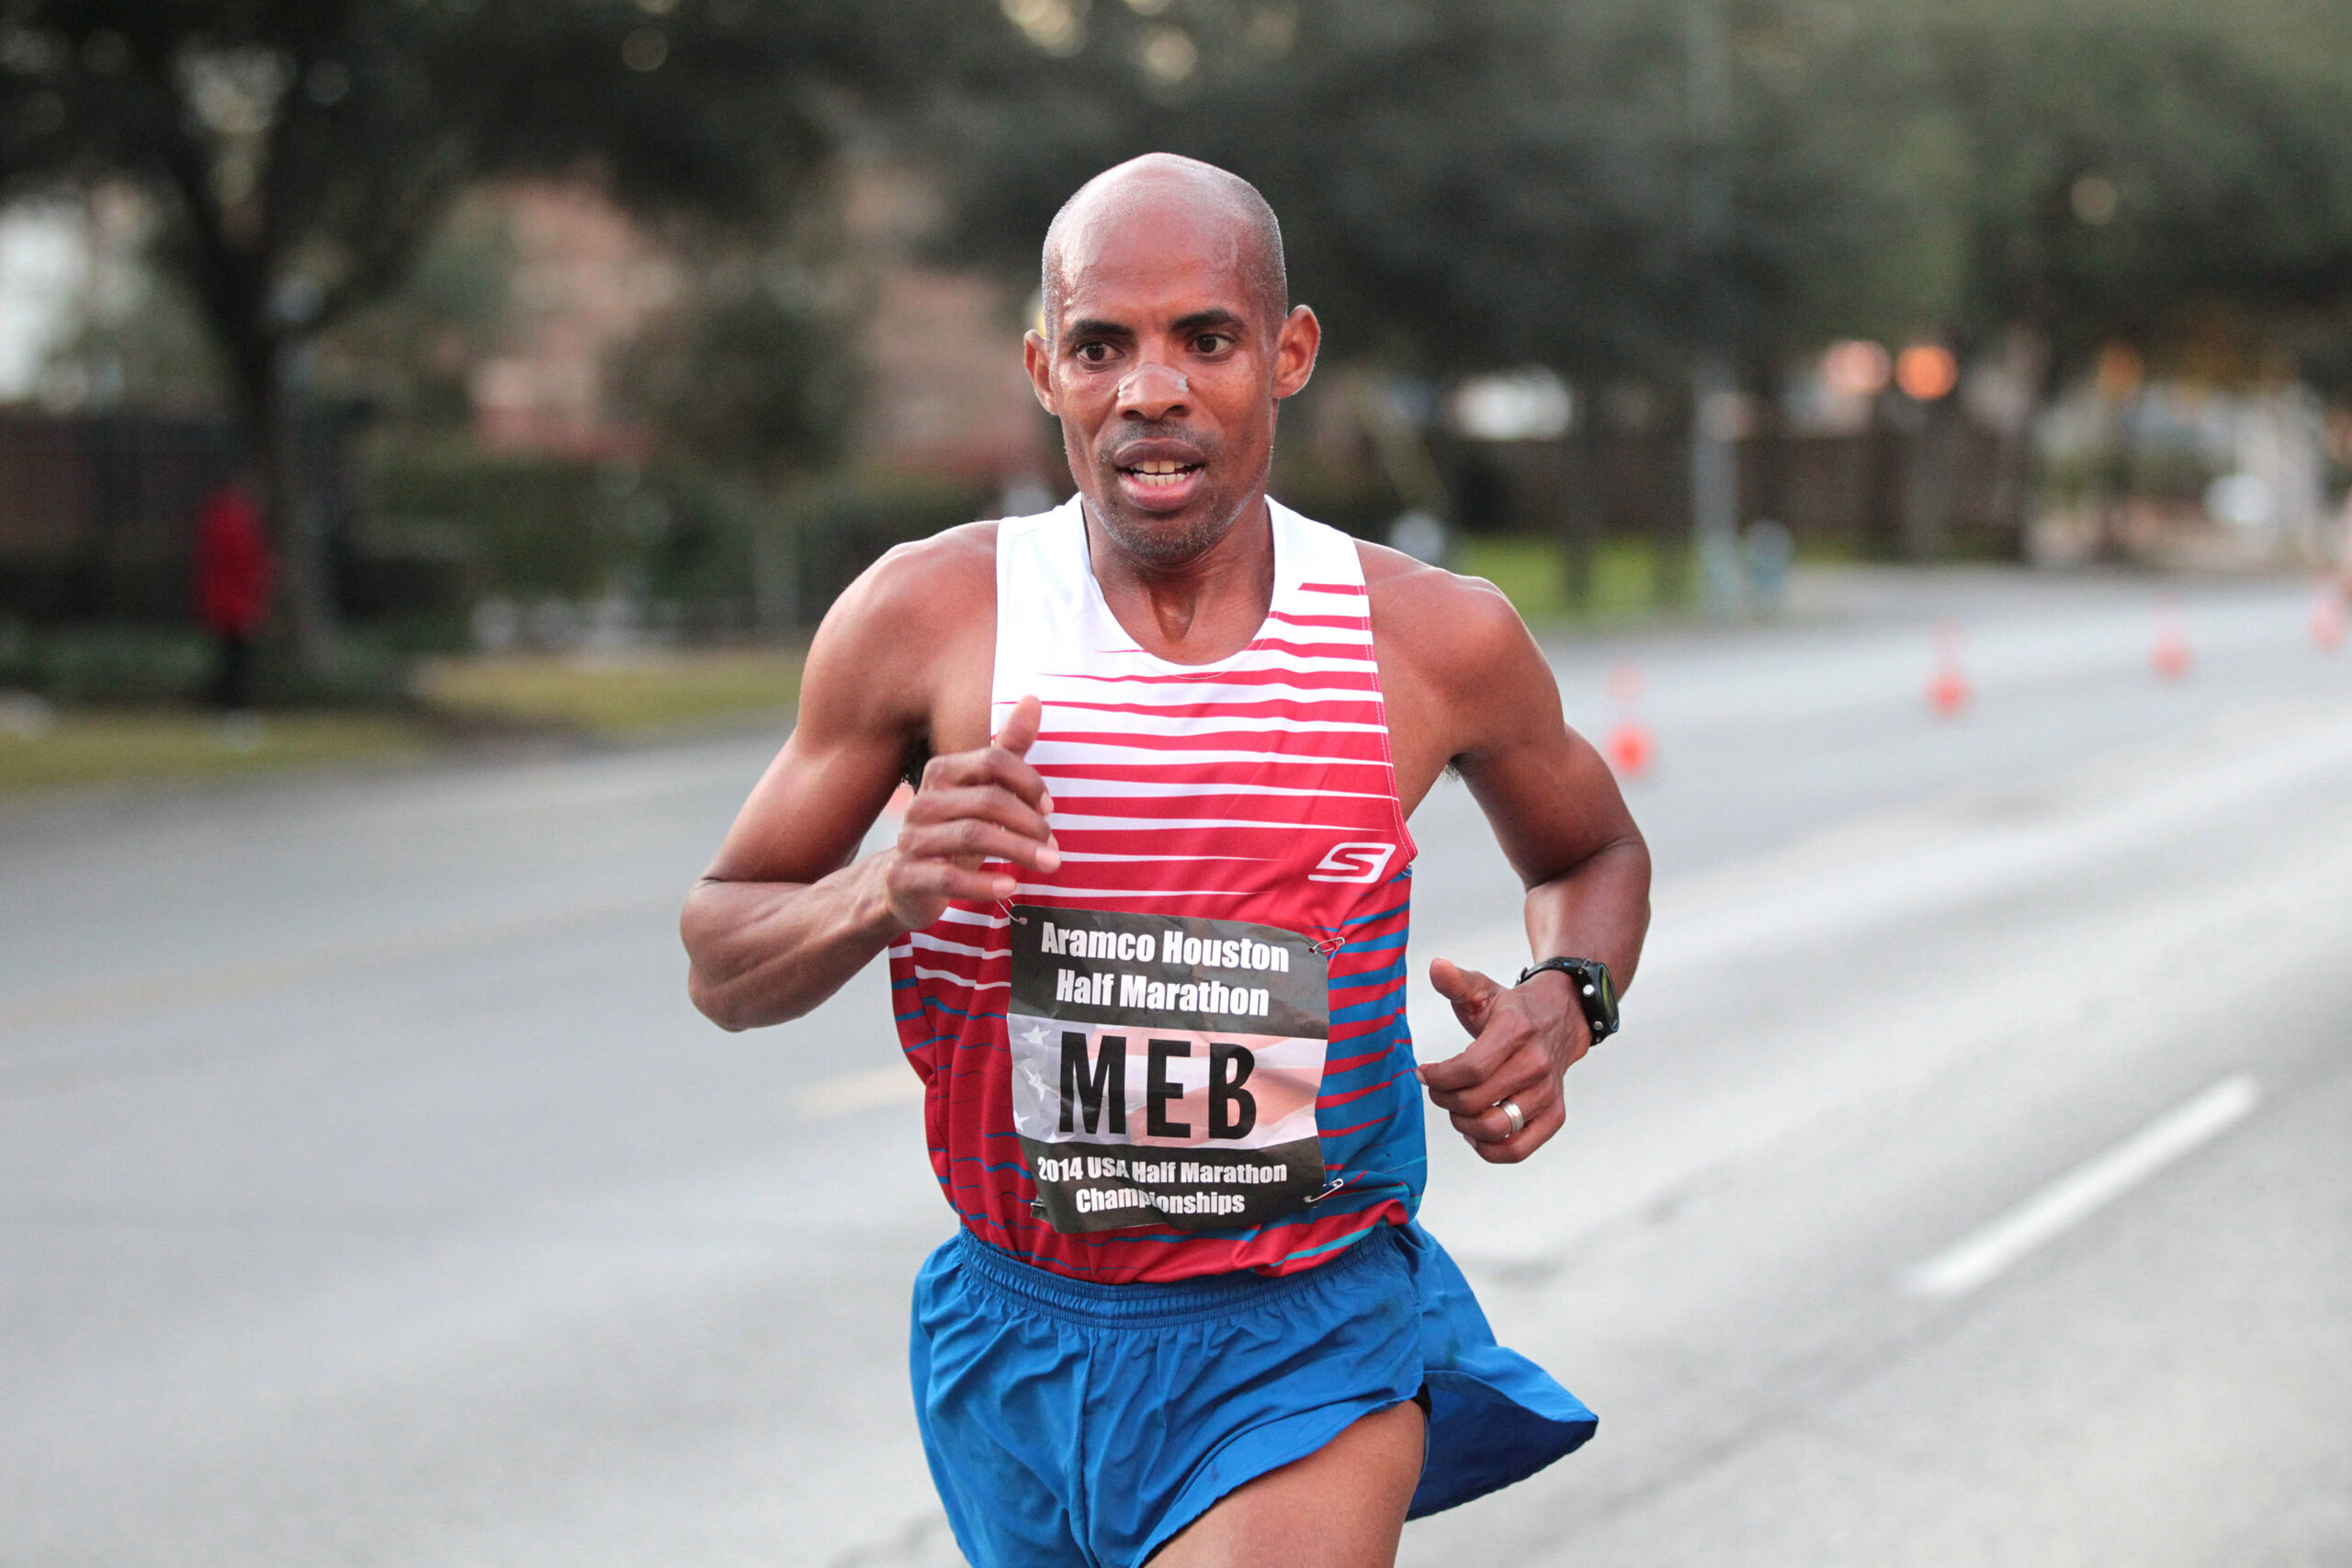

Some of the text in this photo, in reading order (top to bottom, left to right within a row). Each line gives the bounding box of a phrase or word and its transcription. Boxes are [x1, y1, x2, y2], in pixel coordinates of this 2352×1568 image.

[1041, 921, 1289, 973] Aramco Houston
[1056, 968, 1270, 1017] Half Marathon
[1058, 1031, 1257, 1140] MEB
[1037, 1156, 1287, 1184] 2014 USA Half Marathon
[1076, 1187, 1245, 1215] Championships
